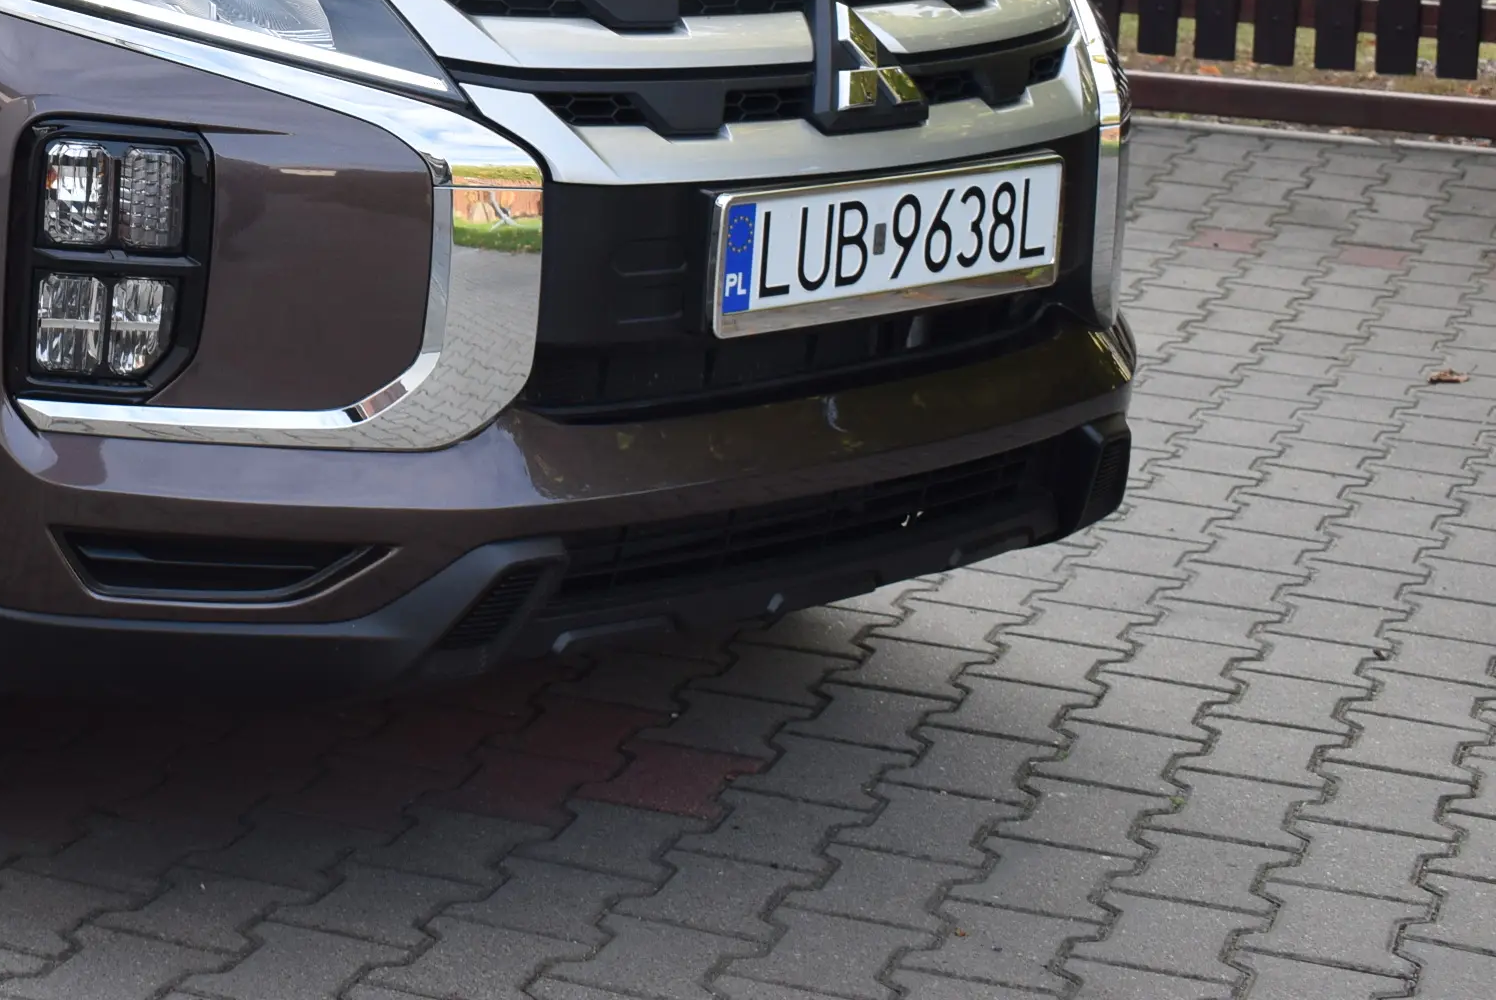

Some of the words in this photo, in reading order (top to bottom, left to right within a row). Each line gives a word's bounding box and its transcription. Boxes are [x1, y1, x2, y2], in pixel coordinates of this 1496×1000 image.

[758, 200, 869, 298] LUB
[889, 178, 1046, 280] 9638L
[724, 272, 747, 297] PL
